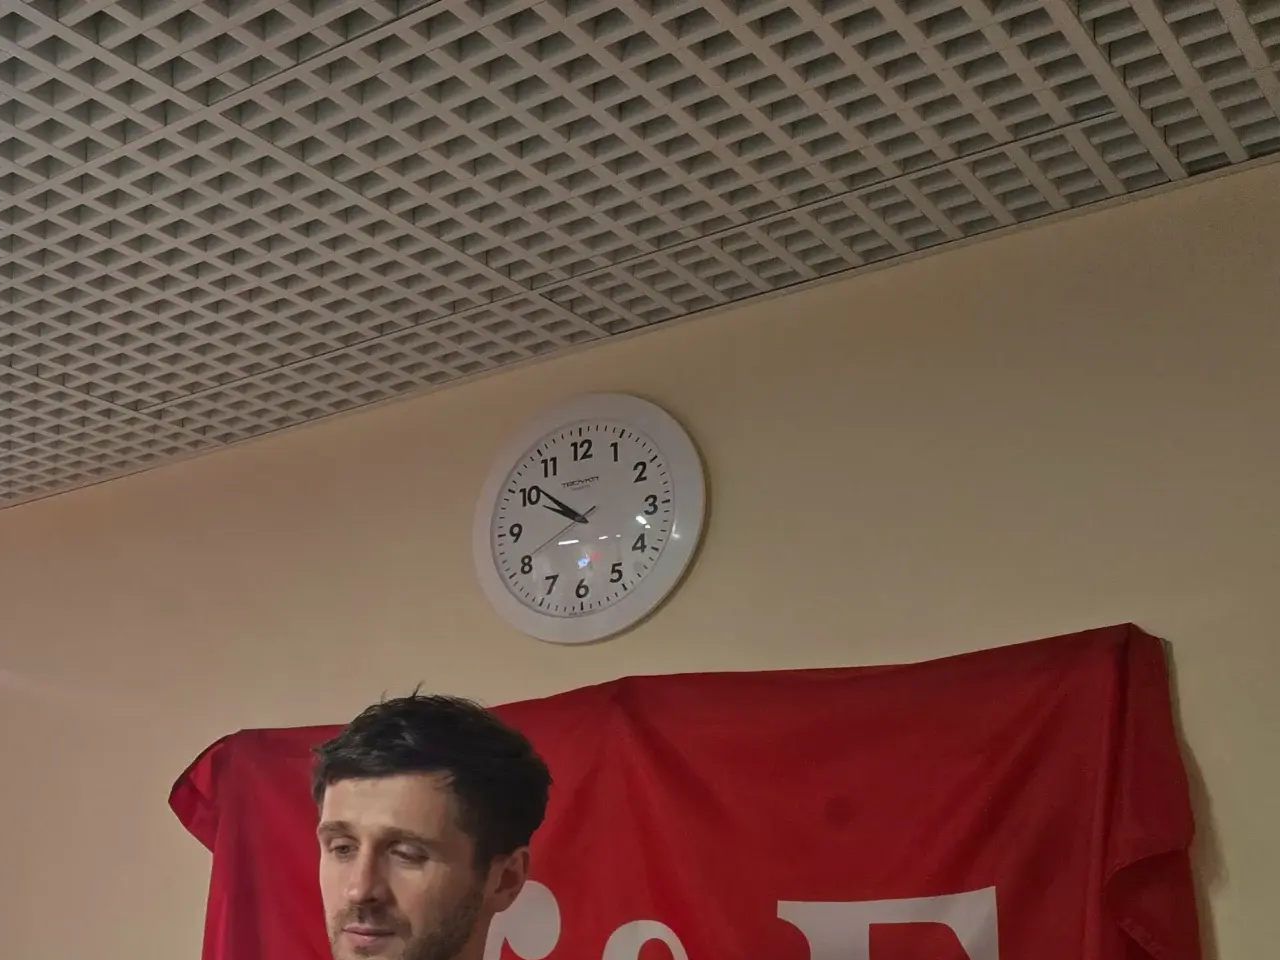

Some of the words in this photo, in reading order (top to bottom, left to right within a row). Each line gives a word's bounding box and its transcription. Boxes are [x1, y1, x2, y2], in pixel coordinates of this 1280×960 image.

[570, 439, 593, 461] 12
[610, 442, 618, 462] 1
[541, 457, 558, 478] 11
[633, 462, 647, 483] 2
[519, 485, 541, 507] 10
[644, 495, 658, 516] 3
[509, 523, 523, 543] 9
[632, 533, 647, 553] 4
[520, 555, 533, 575] 8
[610, 562, 623, 583] 5
[545, 574, 559, 595] 7
[575, 579, 589, 599] 6
